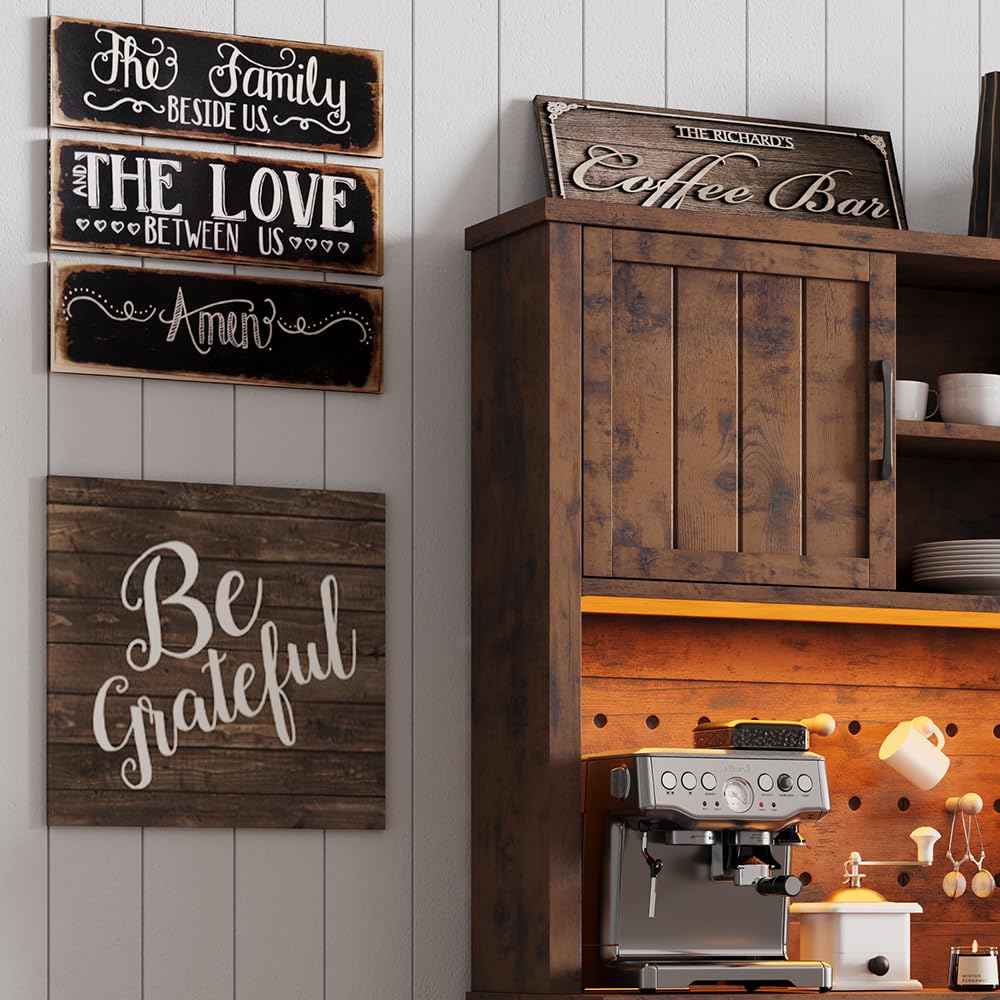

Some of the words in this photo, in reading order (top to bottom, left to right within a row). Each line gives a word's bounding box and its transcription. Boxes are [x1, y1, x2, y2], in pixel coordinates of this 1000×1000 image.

[91, 29, 178, 91] The
[209, 43, 346, 126] Family
[168, 96, 237, 131] BESIDE
[242, 104, 271, 134] US,
[675, 125, 710, 140] THE
[712, 129, 795, 149] RICHARD'S
[72, 164, 88, 198] AND
[74, 151, 183, 215] THE
[210, 163, 357, 233] LOVE
[572, 144, 761, 209] Coffee
[769, 169, 890, 219] Bar
[145, 217, 239, 252] BETWEEN
[259, 227, 284, 256] US
[121, 540, 262, 672] Be
[93, 574, 357, 790] Grateful
